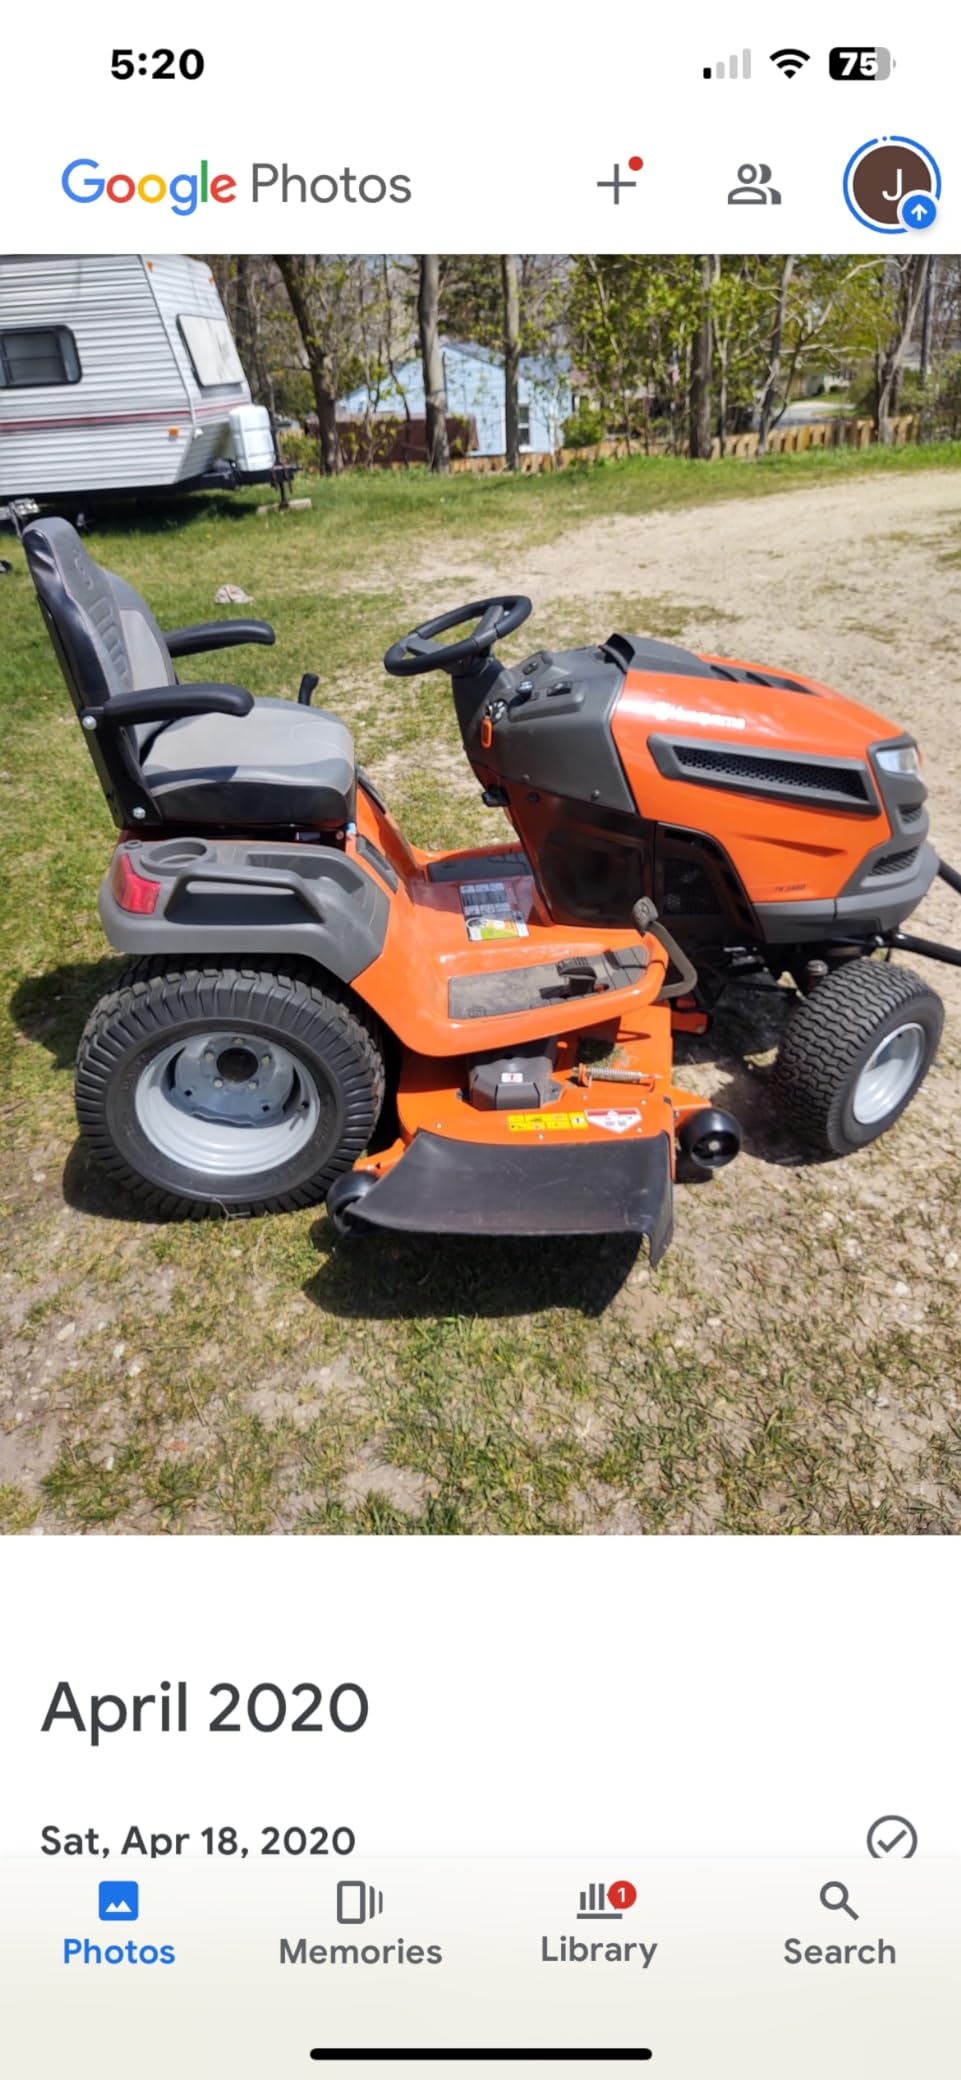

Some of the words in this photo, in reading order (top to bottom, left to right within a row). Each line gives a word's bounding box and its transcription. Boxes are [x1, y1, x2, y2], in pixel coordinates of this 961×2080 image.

[110, 48, 205, 80] 5:20
[839, 51, 879, 77] 75
[61, 157, 238, 217] Google
[252, 162, 412, 204] Photos
[882, 168, 903, 201] J
[40, 1680, 188, 1747] April
[208, 1682, 369, 1733] 2020
[40, 1825, 110, 1858] Sat,
[120, 1825, 191, 1858] Apr
[200, 1825, 249, 1858] 18,
[260, 1825, 356, 1856] 2020
[617, 1887, 626, 1903] 1
[63, 1937, 176, 1965] Photos
[279, 1937, 443, 1965] Memories
[541, 1935, 658, 1969] Library
[783, 1937, 896, 1965] Search
